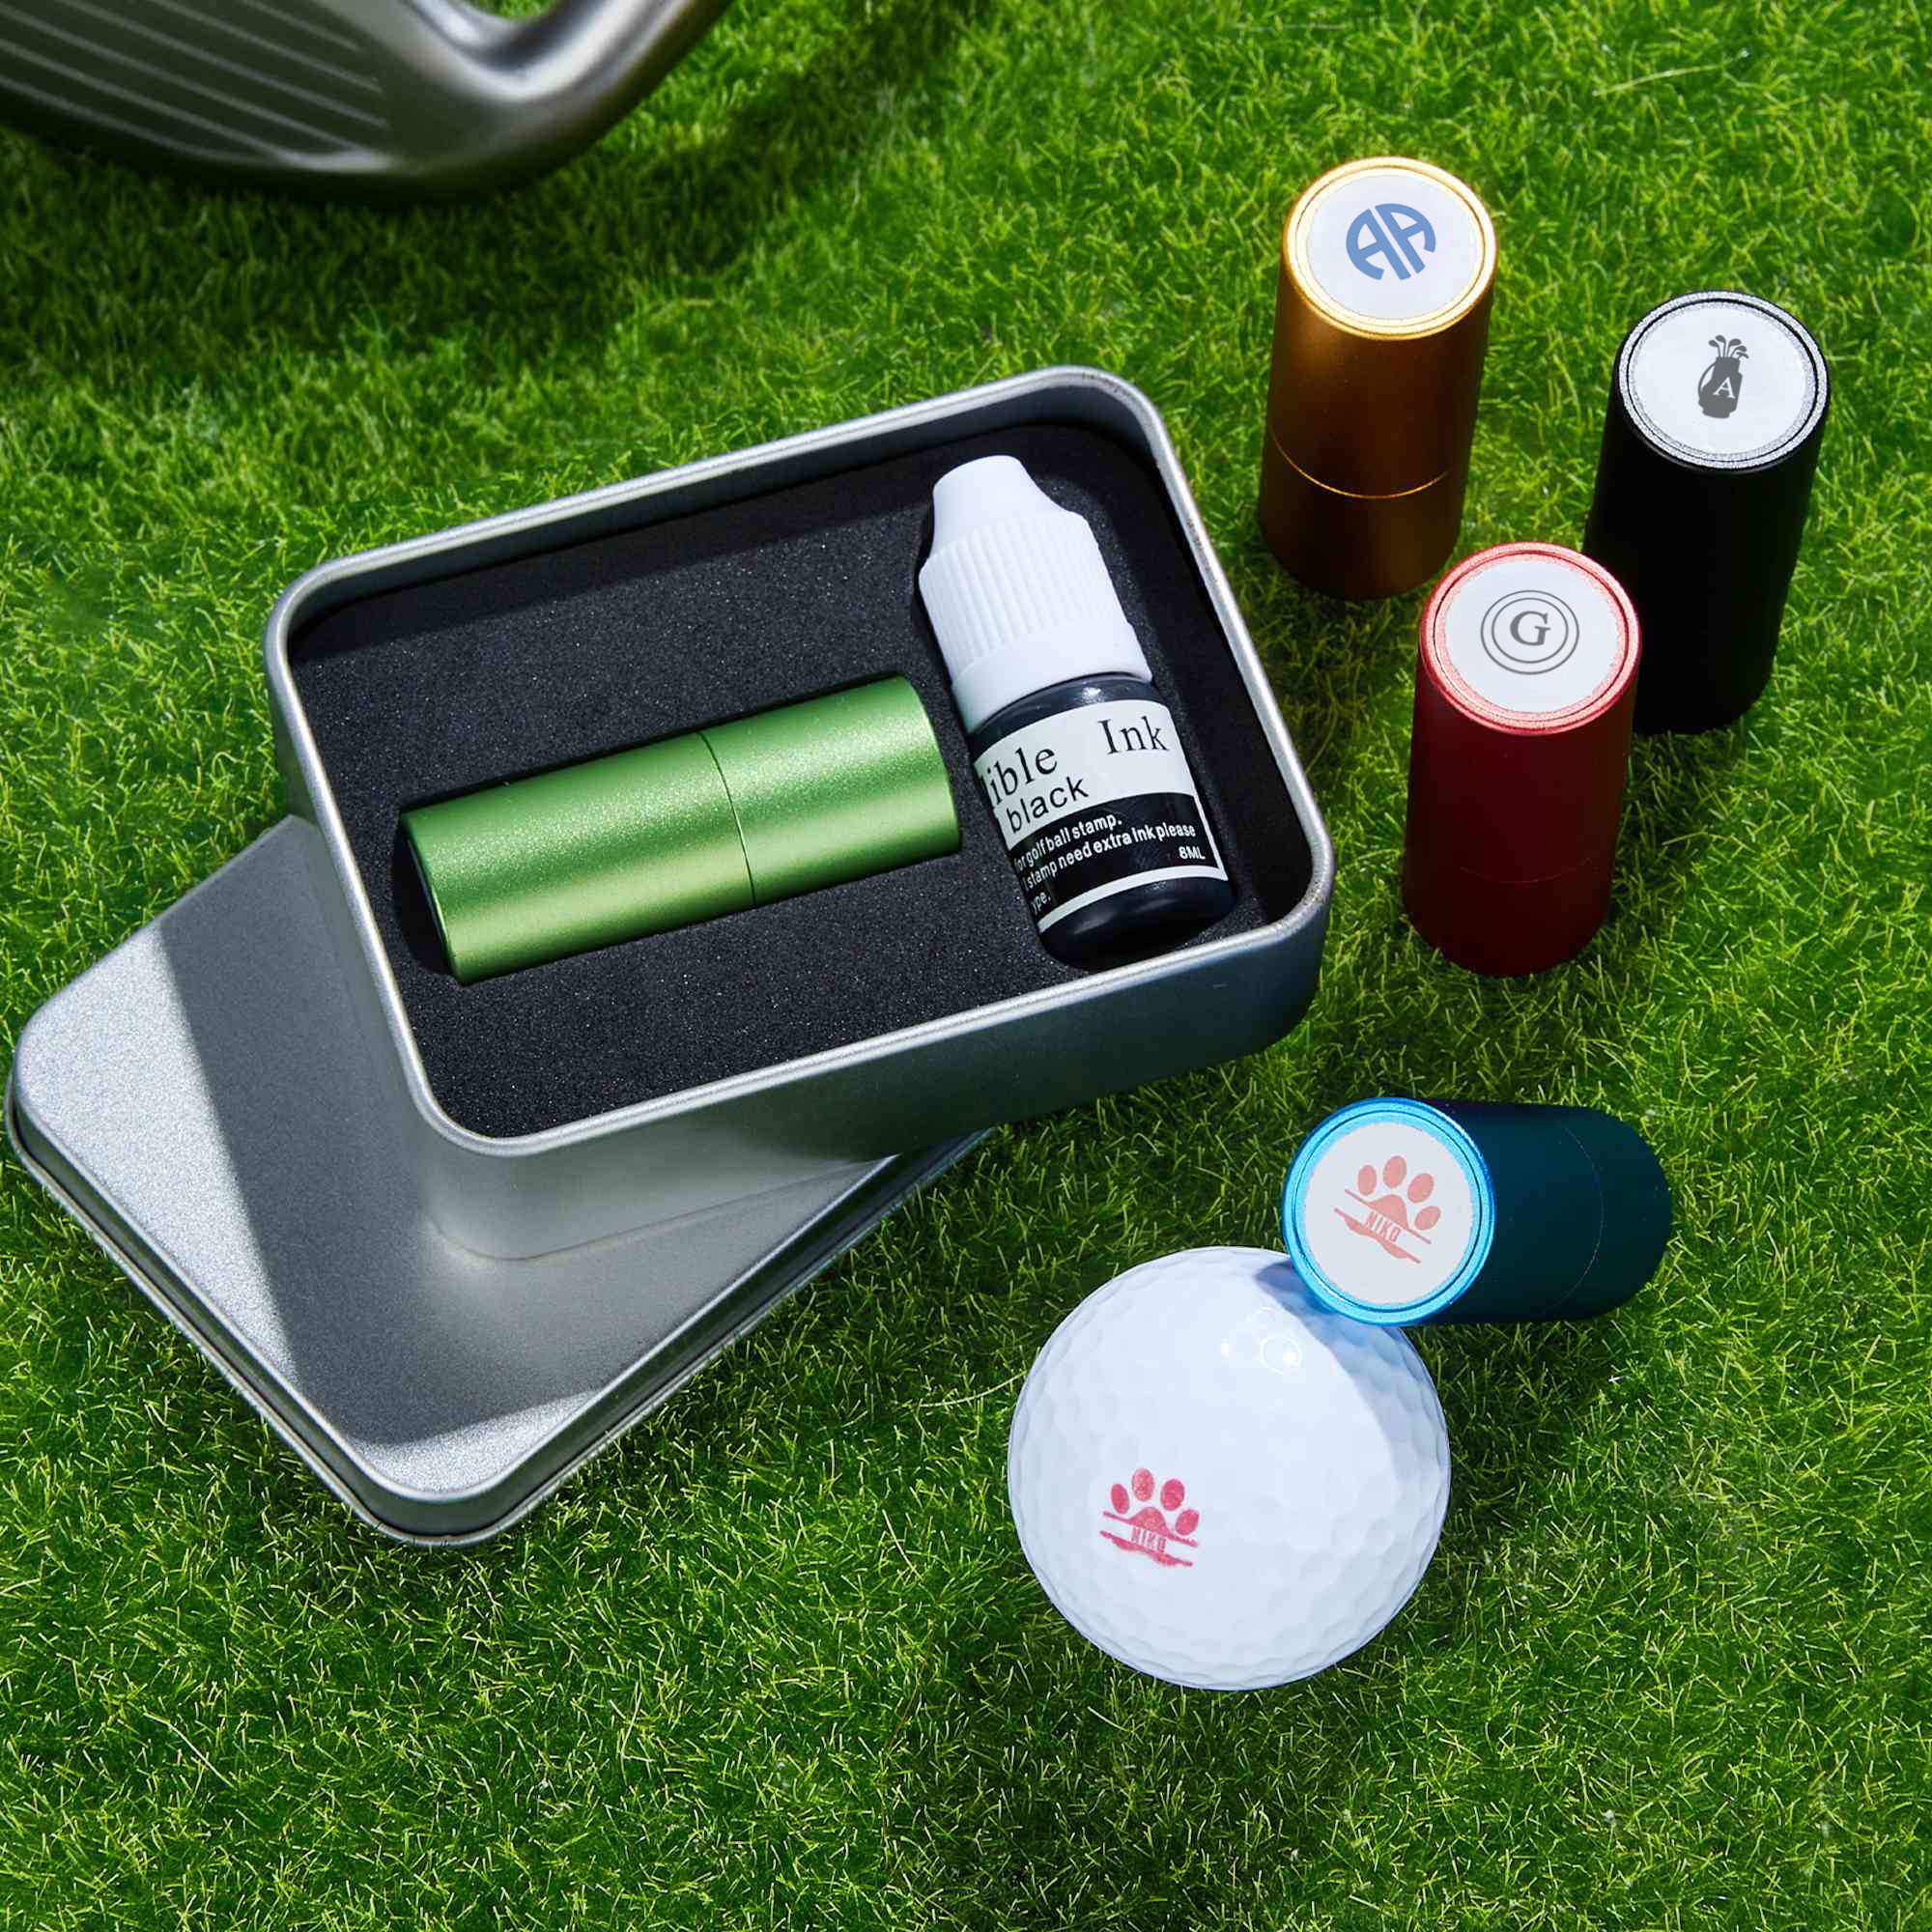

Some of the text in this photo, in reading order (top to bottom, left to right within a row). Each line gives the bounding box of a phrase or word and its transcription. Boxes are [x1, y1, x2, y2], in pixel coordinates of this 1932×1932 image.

[1712, 376, 1736, 400] A
[1509, 610, 1551, 646] G
[1096, 715, 1170, 755] Ink
[1006, 776, 1089, 834] black
[1025, 838, 1047, 868] golf
[1044, 826, 1072, 852] ball
[1071, 813, 1122, 839] stamp.
[1027, 859, 1058, 889] stamp
[1058, 840, 1093, 869] need
[1093, 831, 1133, 854] extra
[1154, 821, 1197, 842] please
